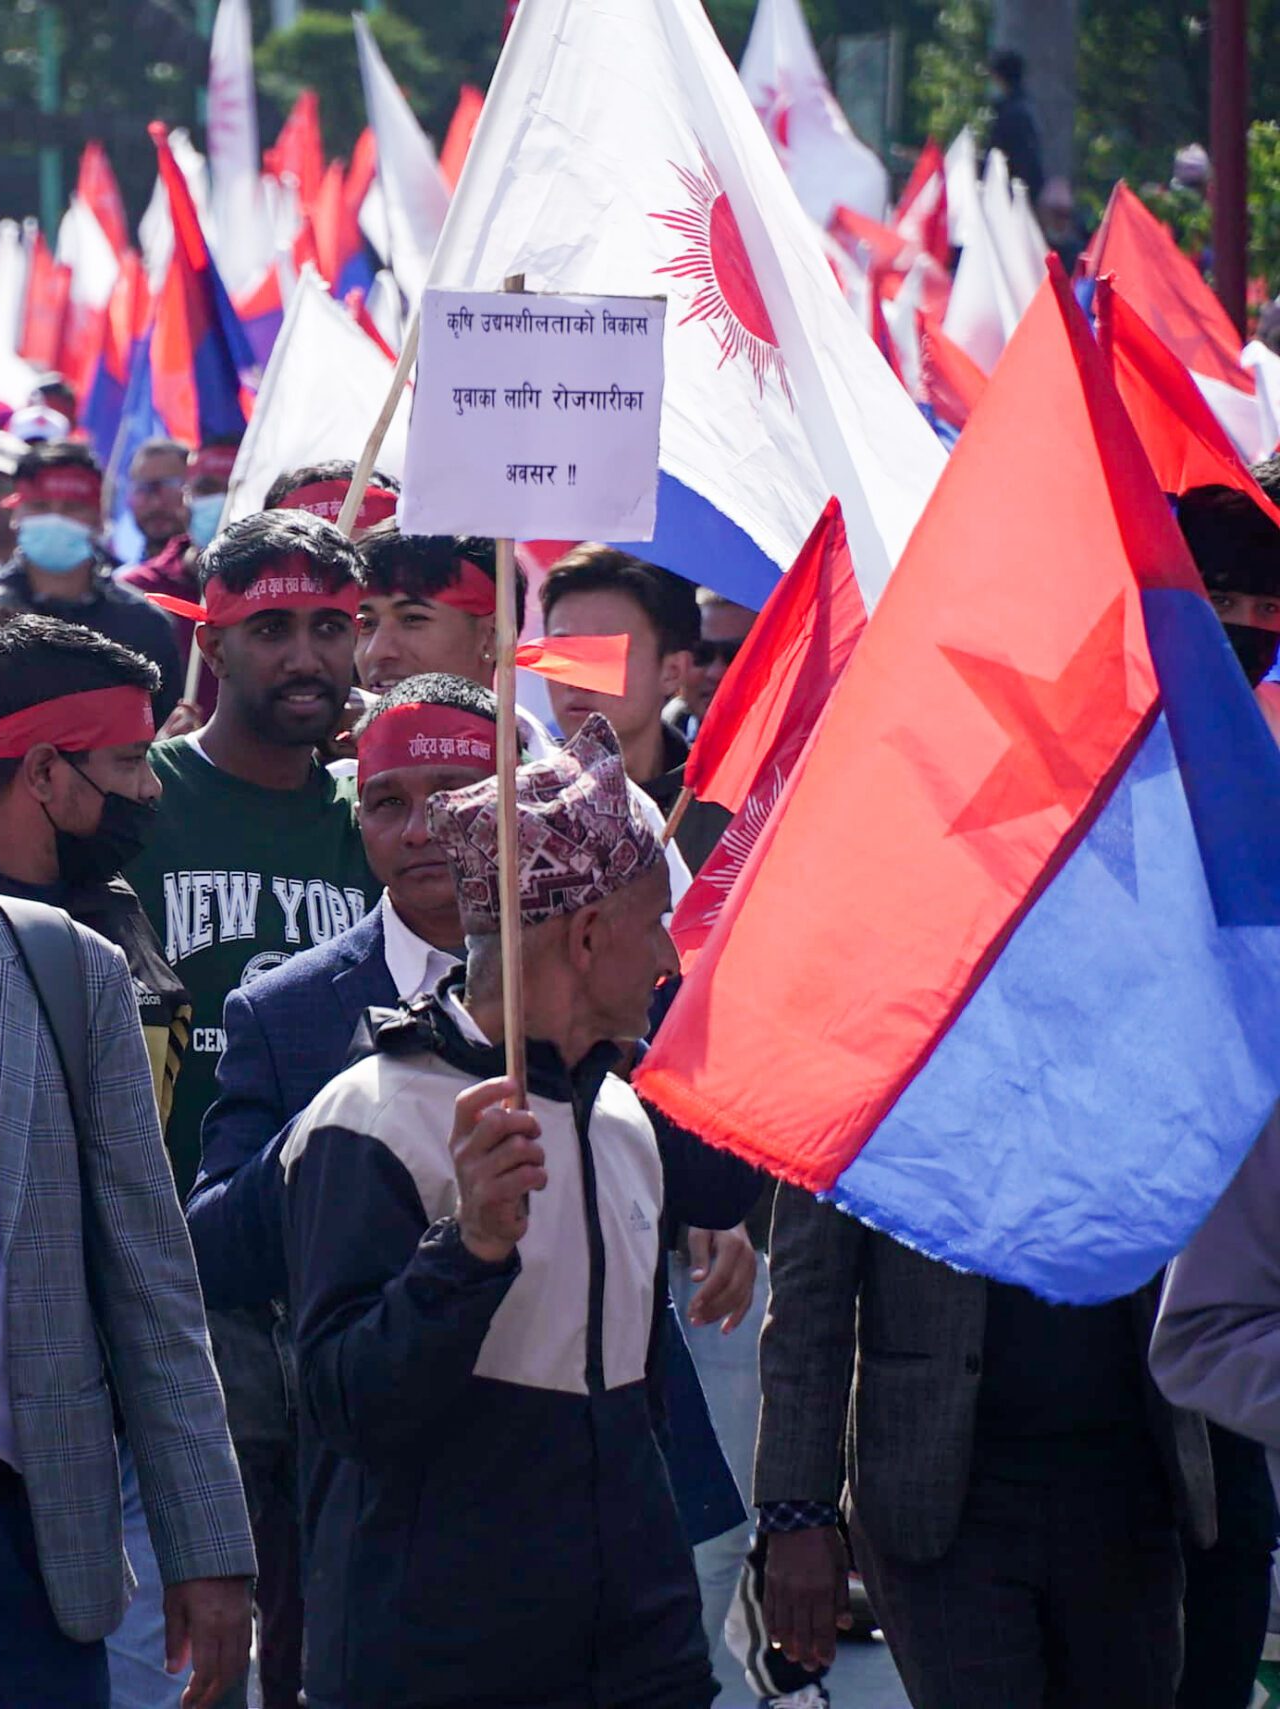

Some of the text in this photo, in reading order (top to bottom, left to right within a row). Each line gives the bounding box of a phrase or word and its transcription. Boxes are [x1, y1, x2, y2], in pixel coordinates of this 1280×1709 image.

[446, 306, 649, 339] कृषि उद्यमशीलताको विकास
[452, 382, 644, 415] युवाका लागि रोजगारीका
[506, 463, 577, 485] अवसर !!
[163, 871, 262, 967] NEW
[192, 1027, 228, 1052] CEN
